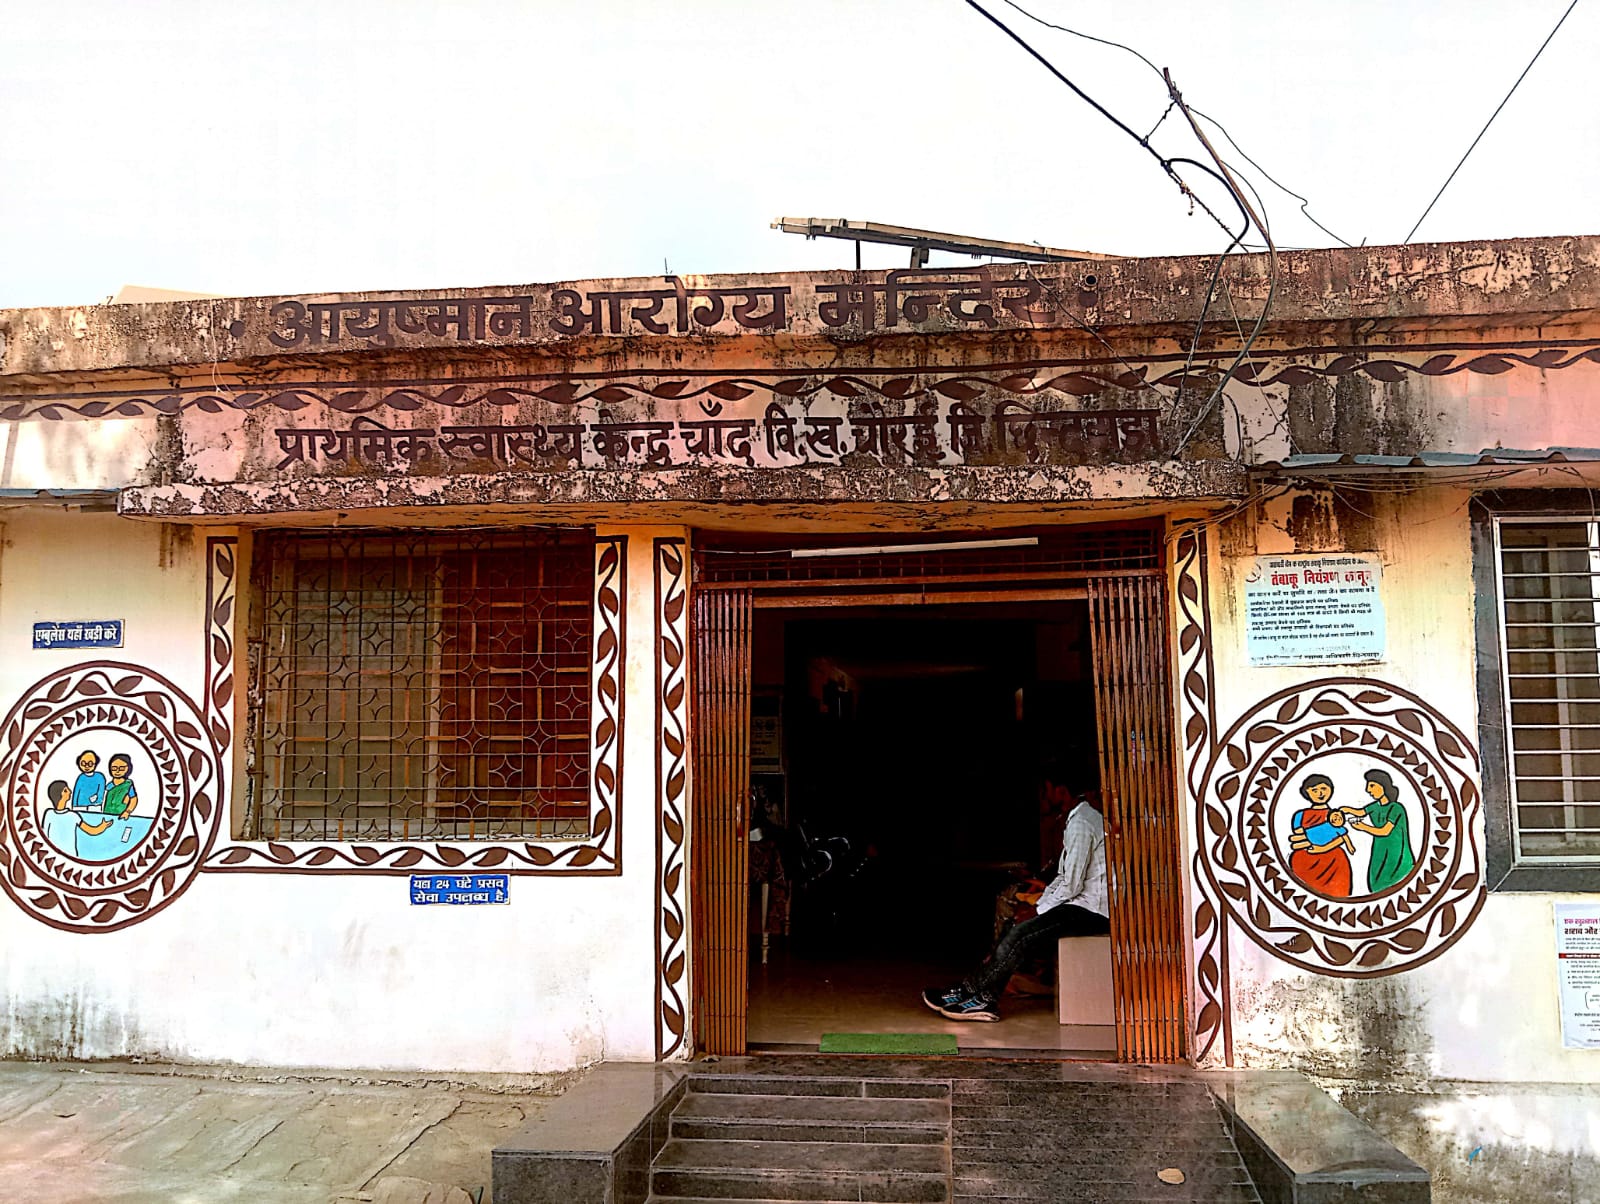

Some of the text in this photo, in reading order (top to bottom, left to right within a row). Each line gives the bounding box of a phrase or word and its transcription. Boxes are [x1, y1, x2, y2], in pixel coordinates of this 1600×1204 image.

[270, 268, 1058, 349] आयुष्मान आरोग्य मन्दिर
[274, 415, 436, 471] प्राथमिक
[438, 423, 586, 464] स्वास्थ्य
[591, 408, 675, 467] केन्द्र
[679, 400, 756, 467] चाँद
[1270, 571, 1299, 589] तंबाकू
[436, 879, 450, 889] 24
[477, 879, 504, 888] प्रसव
[414, 891, 439, 902] सेवा
[446, 892, 489, 902] उपलब्ध
